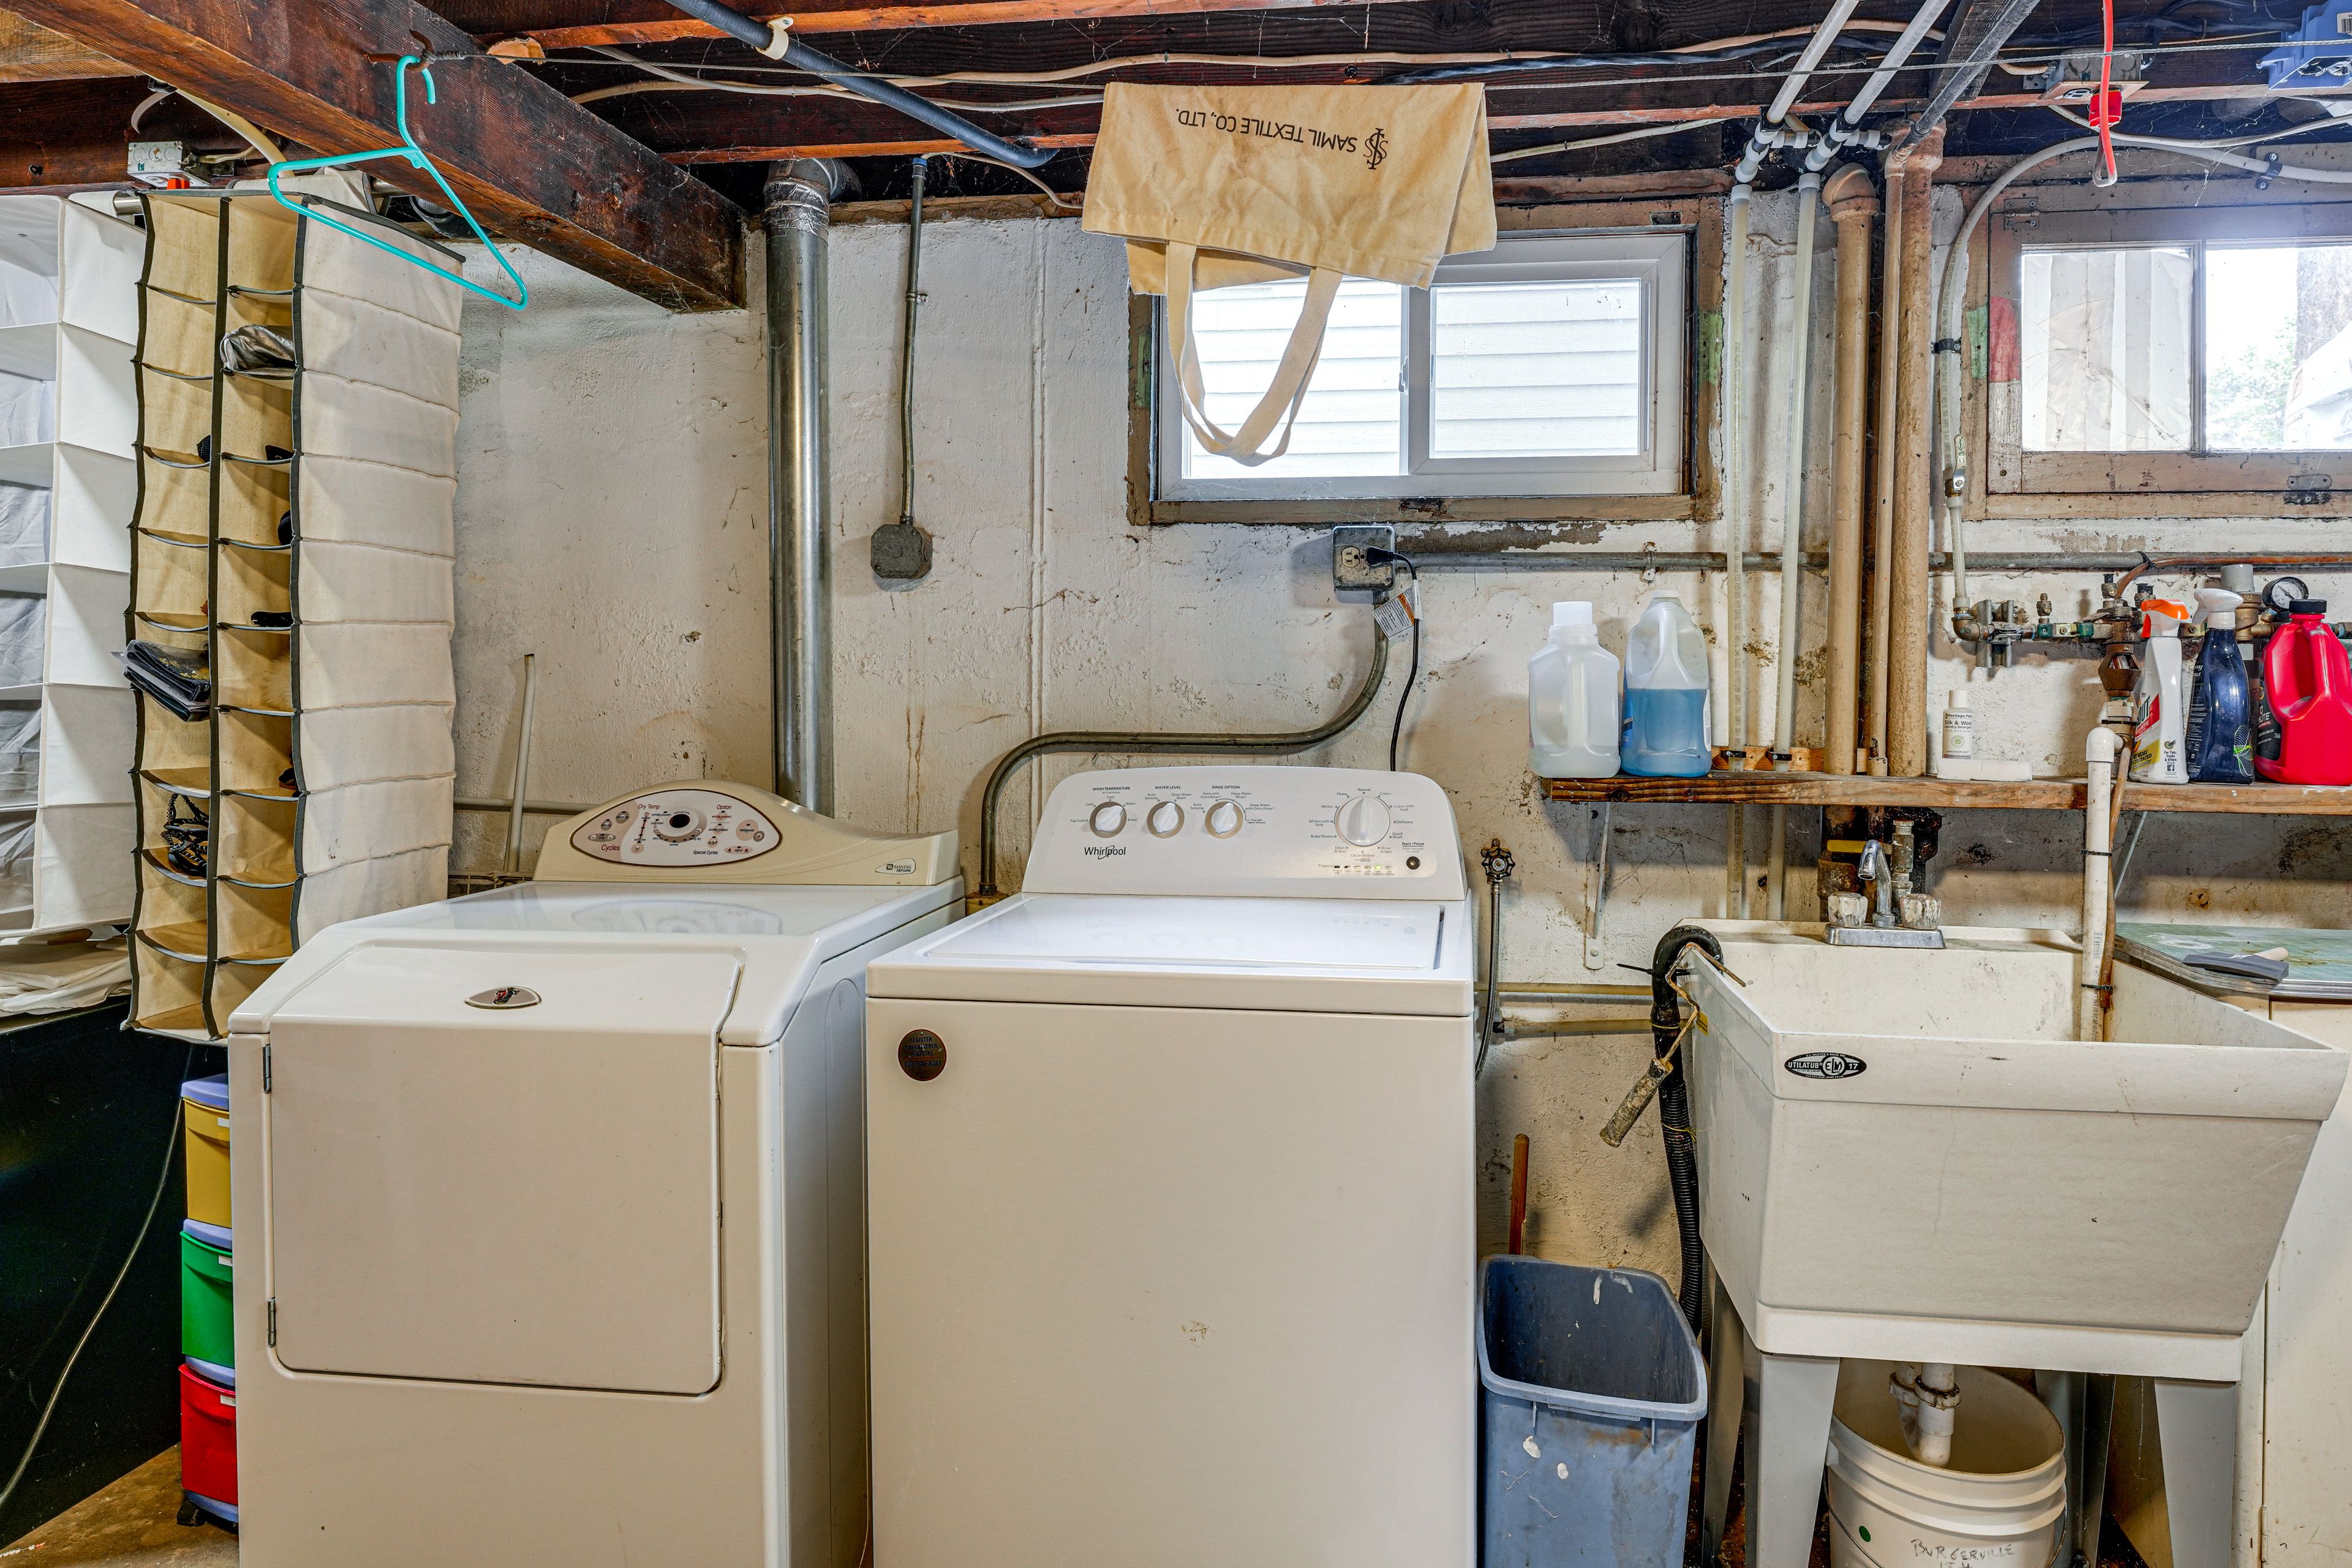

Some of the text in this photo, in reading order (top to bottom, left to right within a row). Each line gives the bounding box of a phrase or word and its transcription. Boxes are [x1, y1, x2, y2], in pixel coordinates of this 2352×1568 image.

[1175, 108, 1206, 127] LTD.
[1240, 116, 1304, 143] TEXTILE
[1308, 128, 1358, 153] SAMIL
[1084, 846, 1126, 859] Whirlpool
